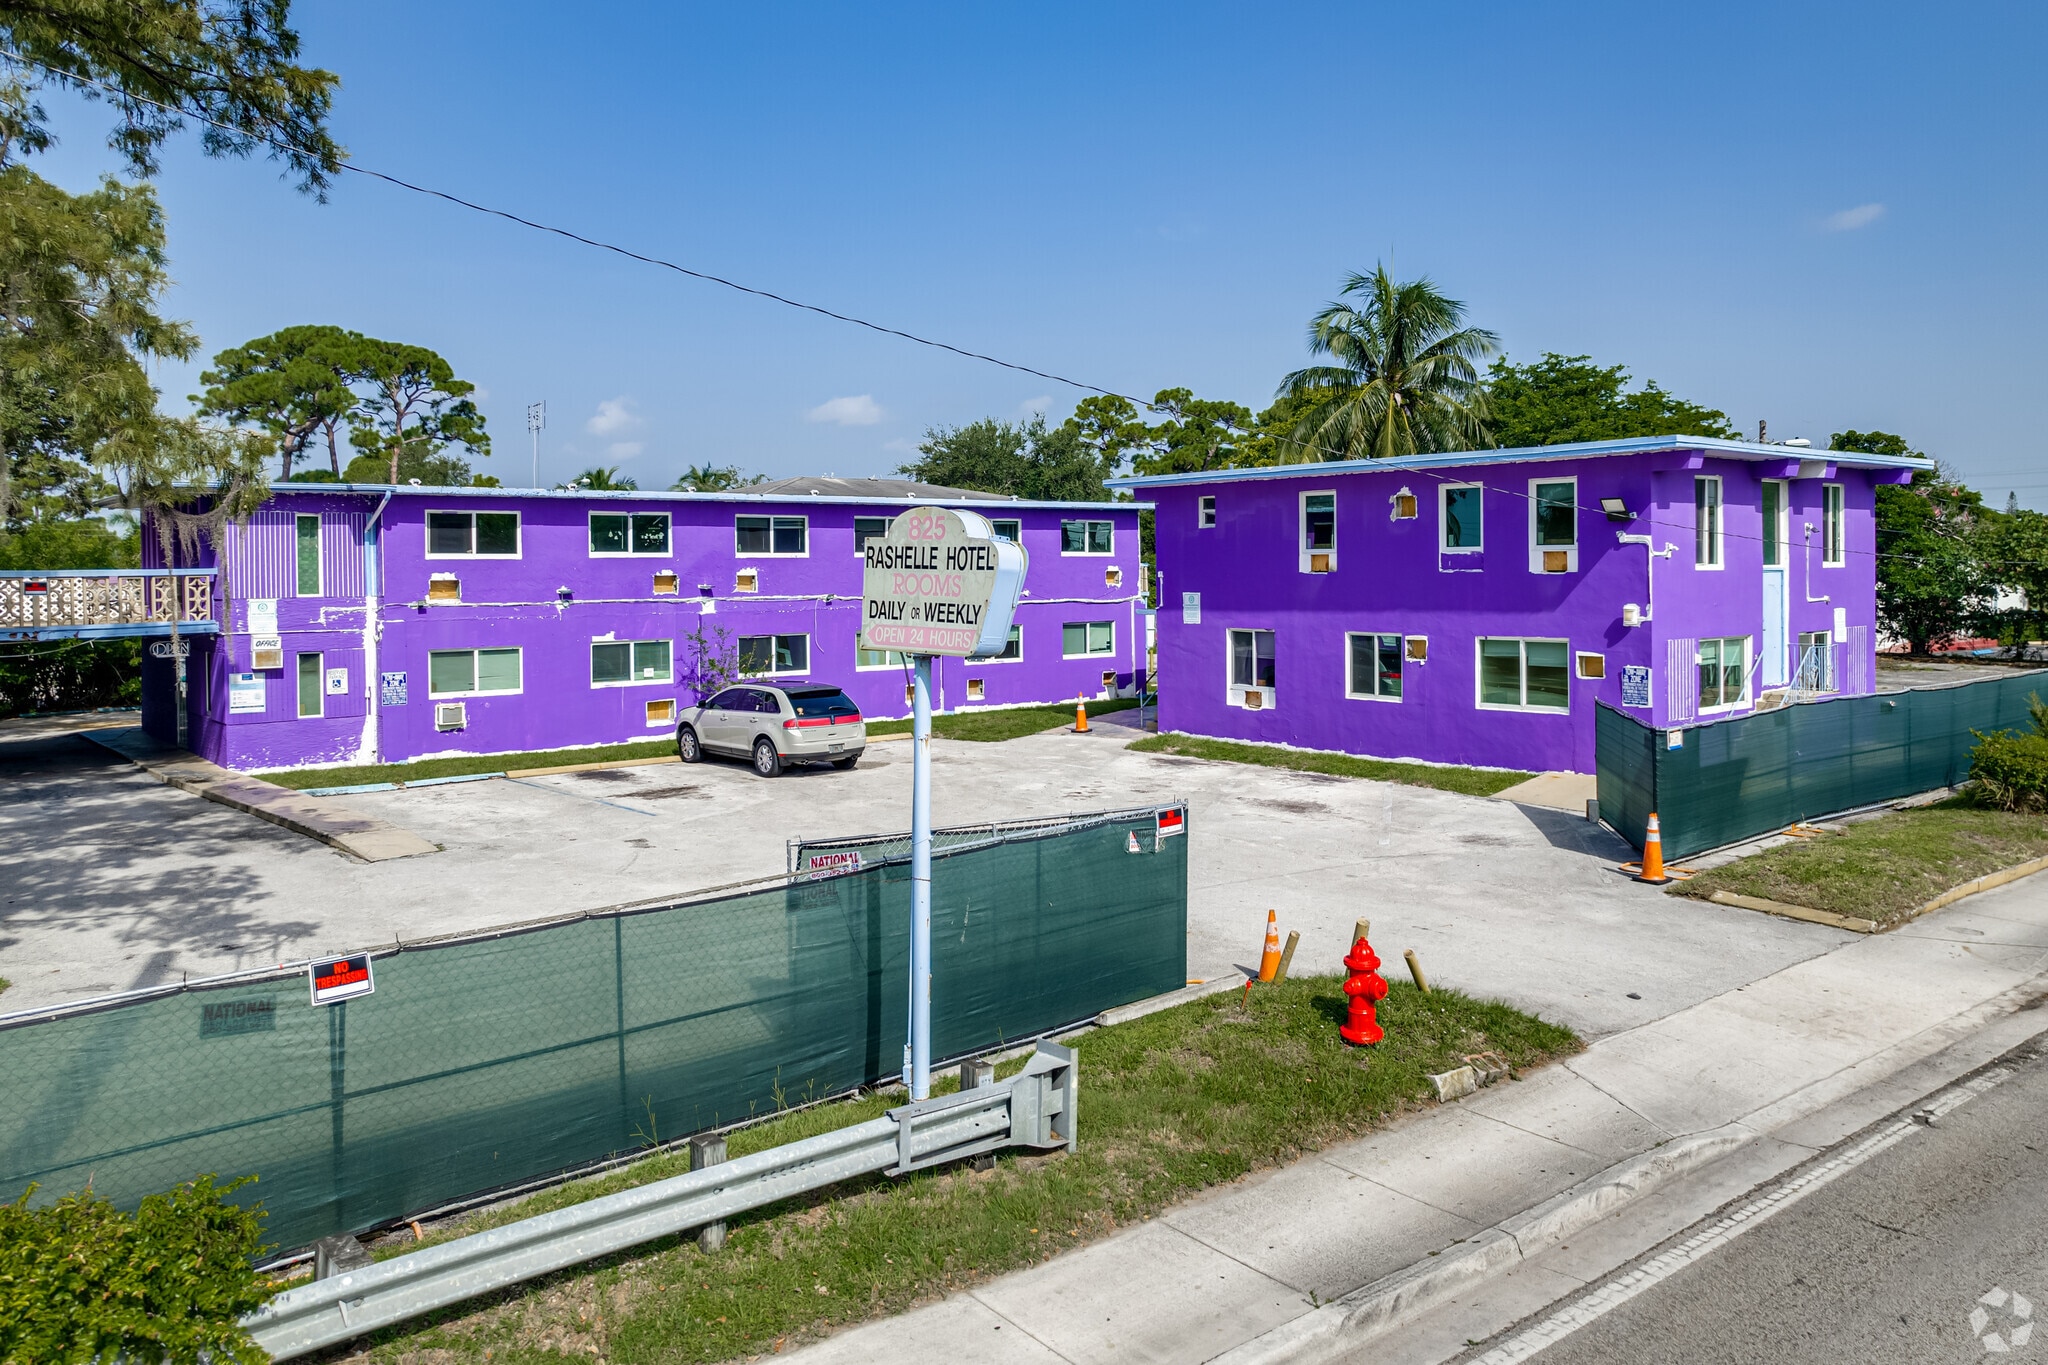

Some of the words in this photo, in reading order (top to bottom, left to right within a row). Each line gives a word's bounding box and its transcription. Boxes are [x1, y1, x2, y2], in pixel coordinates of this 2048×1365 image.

[908, 515, 946, 541] 825
[866, 545, 938, 570] RASHELLE
[946, 546, 995, 571] HOTEL
[892, 572, 962, 598] ROOMS
[869, 600, 906, 621] DAILY
[911, 607, 920, 620] OR
[924, 602, 982, 625] WEEKLY
[255, 639, 279, 648] OFFICE
[875, 626, 905, 643] OPEN
[910, 628, 924, 645] 24
[929, 629, 971, 648] HOURS
[150, 641, 190, 656] OPN
[333, 960, 350, 974] NO
[315, 968, 369, 990] TRESPASSING
